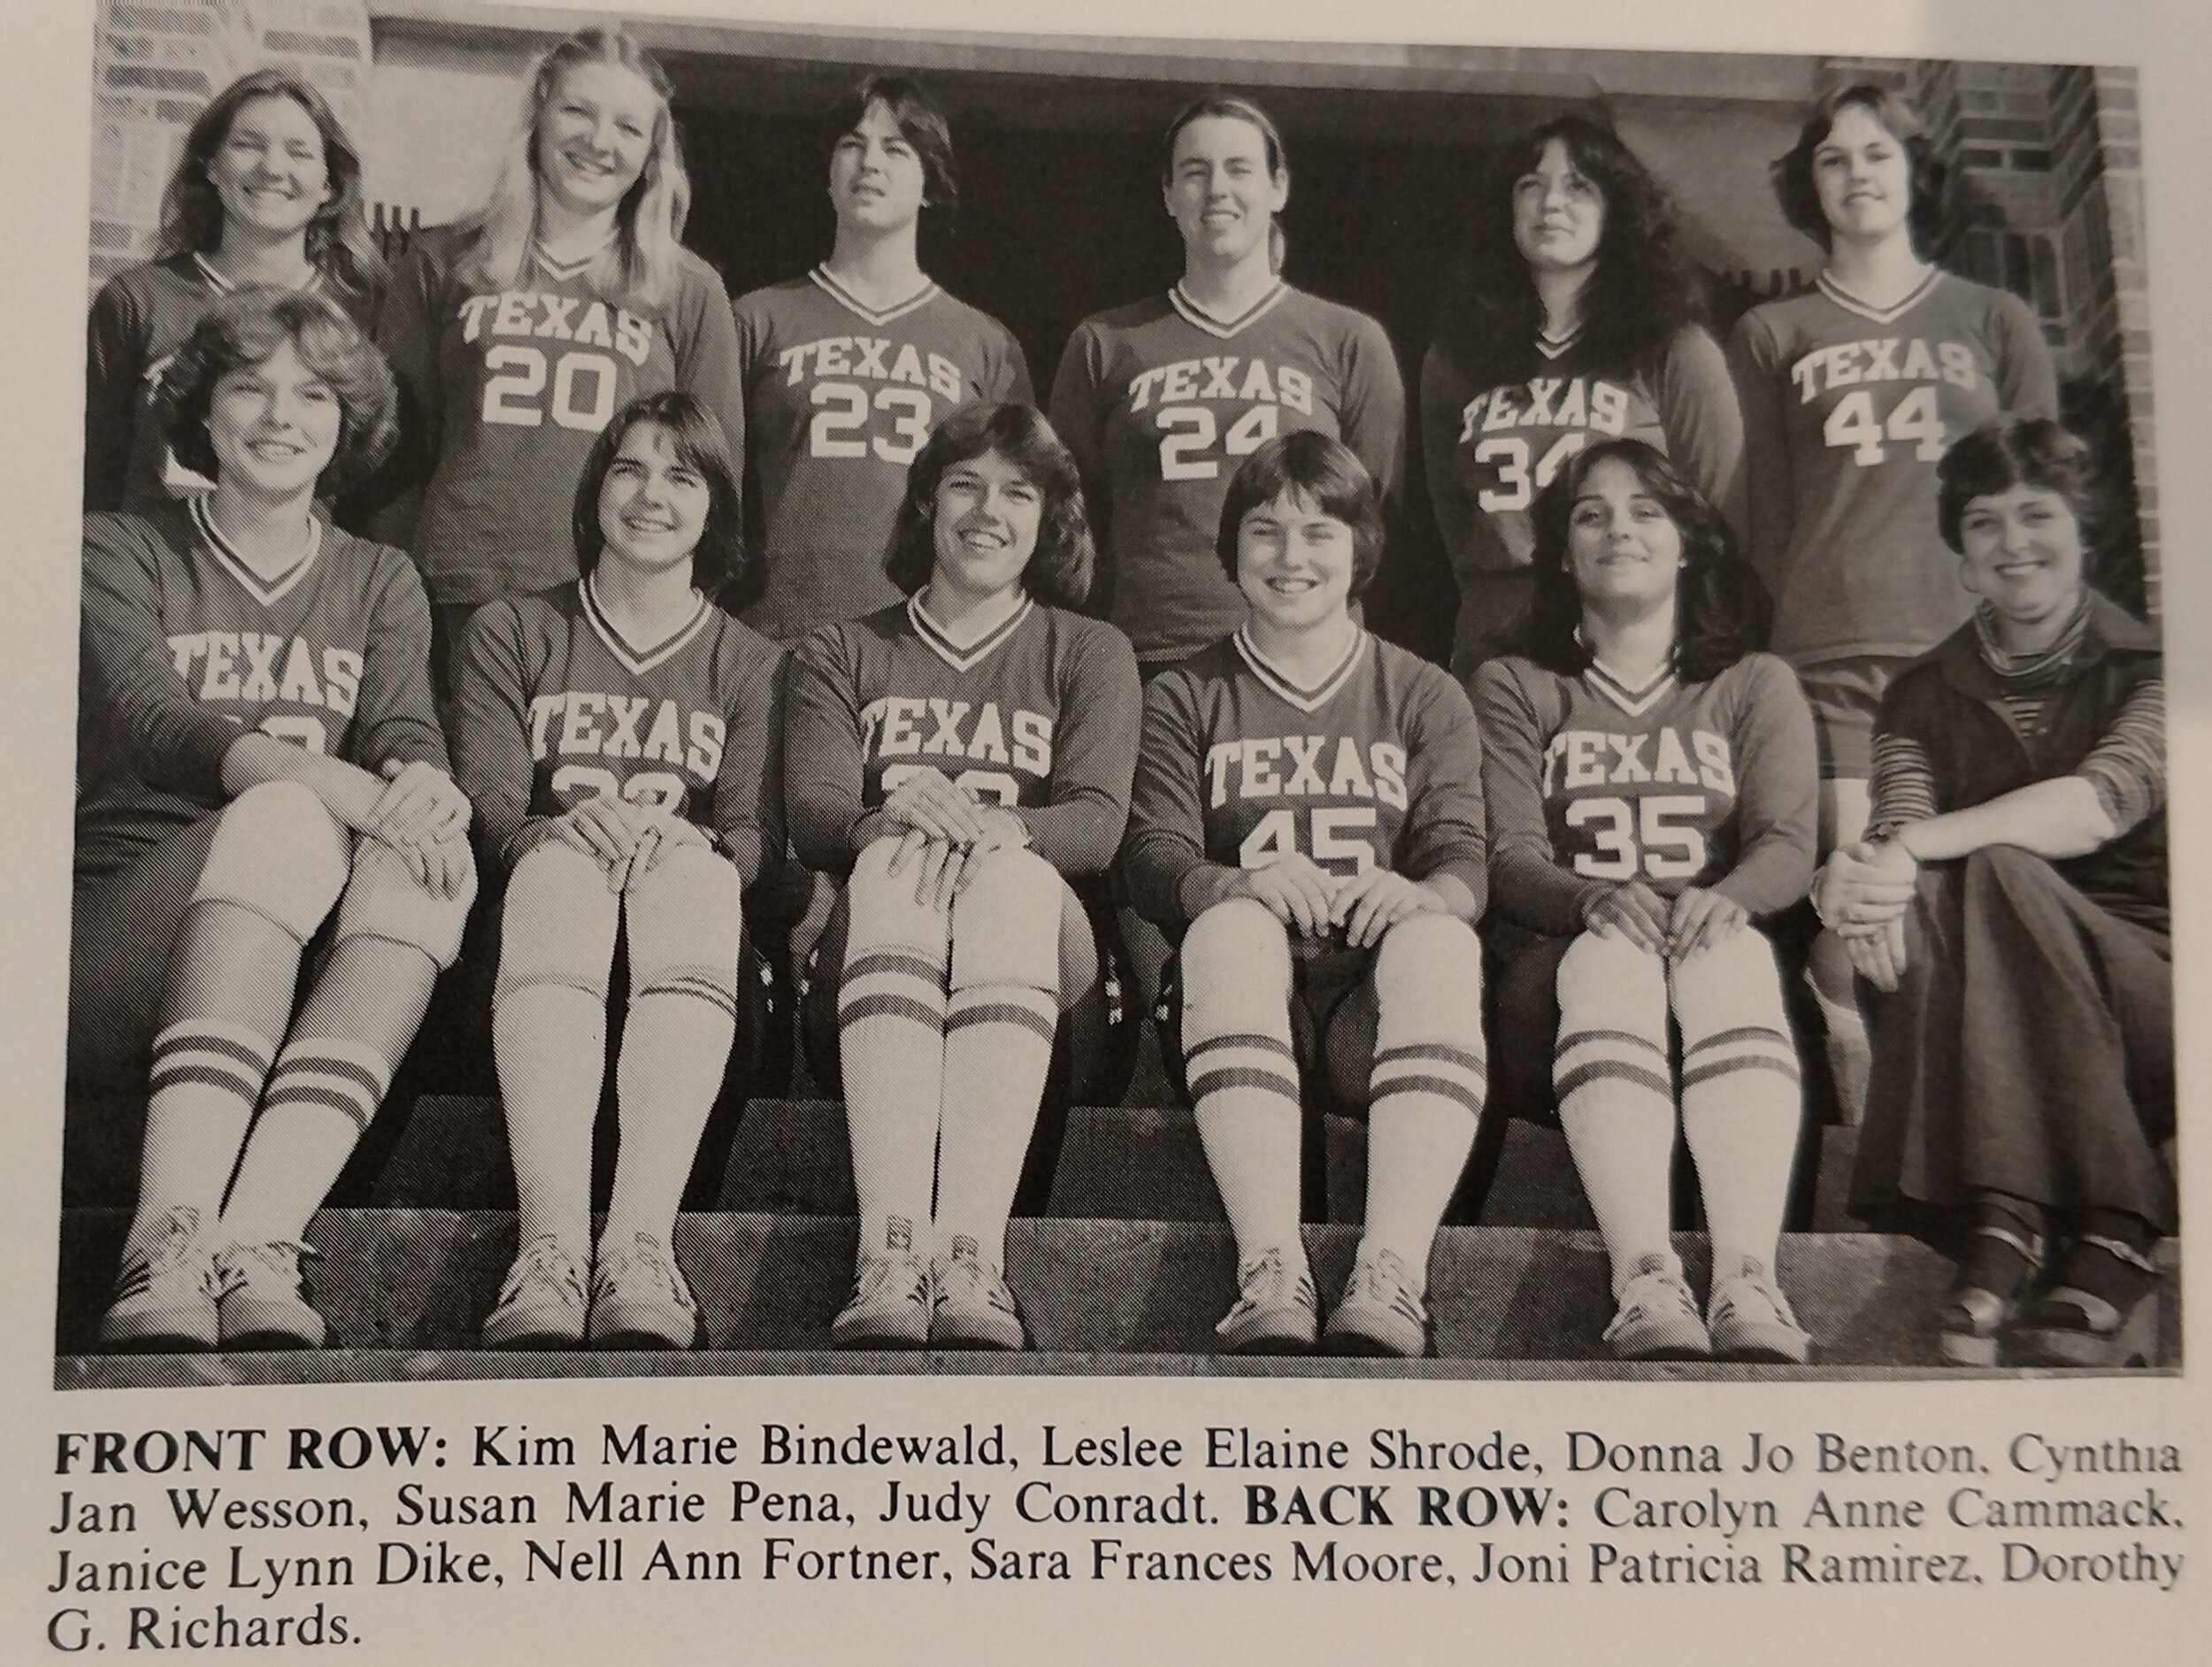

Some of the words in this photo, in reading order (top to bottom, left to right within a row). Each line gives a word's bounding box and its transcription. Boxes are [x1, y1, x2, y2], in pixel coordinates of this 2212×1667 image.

[457, 291, 652, 366] TEXAS
[482, 345, 617, 433] 20
[780, 336, 961, 403] TEXAS
[1129, 357, 1312, 413] TEXAS
[1791, 338, 1977, 404] TEXAS
[810, 382, 932, 465] 23
[1458, 377, 1629, 443] TEXAS
[1823, 386, 1946, 466] 44
[166, 631, 364, 718] TEXAS
[528, 691, 727, 783] TEXAS
[1204, 735, 1407, 811] TEXAS
[1240, 807, 1376, 887] 45
[1565, 795, 1706, 880] 35
[55, 1430, 265, 1474] FRONT
[288, 1426, 446, 1470] ROW:
[472, 1425, 575, 1466] Kim
[602, 1424, 737, 1464] Marie
[761, 1424, 1018, 1471] Bindewald,
[1042, 1425, 1182, 1467] Leslee
[1205, 1427, 1348, 1469] Elaine
[1371, 1429, 1542, 1475] Shrode,
[1566, 1432, 1723, 1472] Donna
[1742, 1433, 1793, 1473] Jo
[2009, 1433, 2182, 1483] Cynthia
[50, 1492, 136, 1533] Jan
[166, 1488, 368, 1532] Wesson,
[396, 1484, 536, 1525] Susan
[566, 1480, 704, 1523] Marie
[731, 1481, 854, 1527] Pena,
[879, 1480, 990, 1533] Judy
[1016, 1481, 1217, 1525] Conradt.
[1244, 1485, 1394, 1525] BACK
[1417, 1486, 1567, 1527] ROW:
[1594, 1487, 1778, 1539] Carolyn
[1804, 1491, 1924, 1528] Anne
[48, 1548, 206, 1593] Janice
[228, 1546, 353, 1599] Lynn
[376, 1540, 503, 1588] Dike,
[525, 1539, 623, 1581] Nell
[641, 1540, 741, 1580] Ann
[764, 1538, 951, 1585] Fortner,
[972, 1538, 1071, 1579] Sara
[1091, 1540, 1271, 1581] Frances
[1292, 1541, 1455, 1586] Moore,
[1473, 1543, 1569, 1583] Joni
[1589, 1543, 1763, 1584] Patricia
[2002, 1542, 2184, 1592] Dorothy
[48, 1609, 105, 1652] G.
[127, 1602, 361, 1649] Richards.
